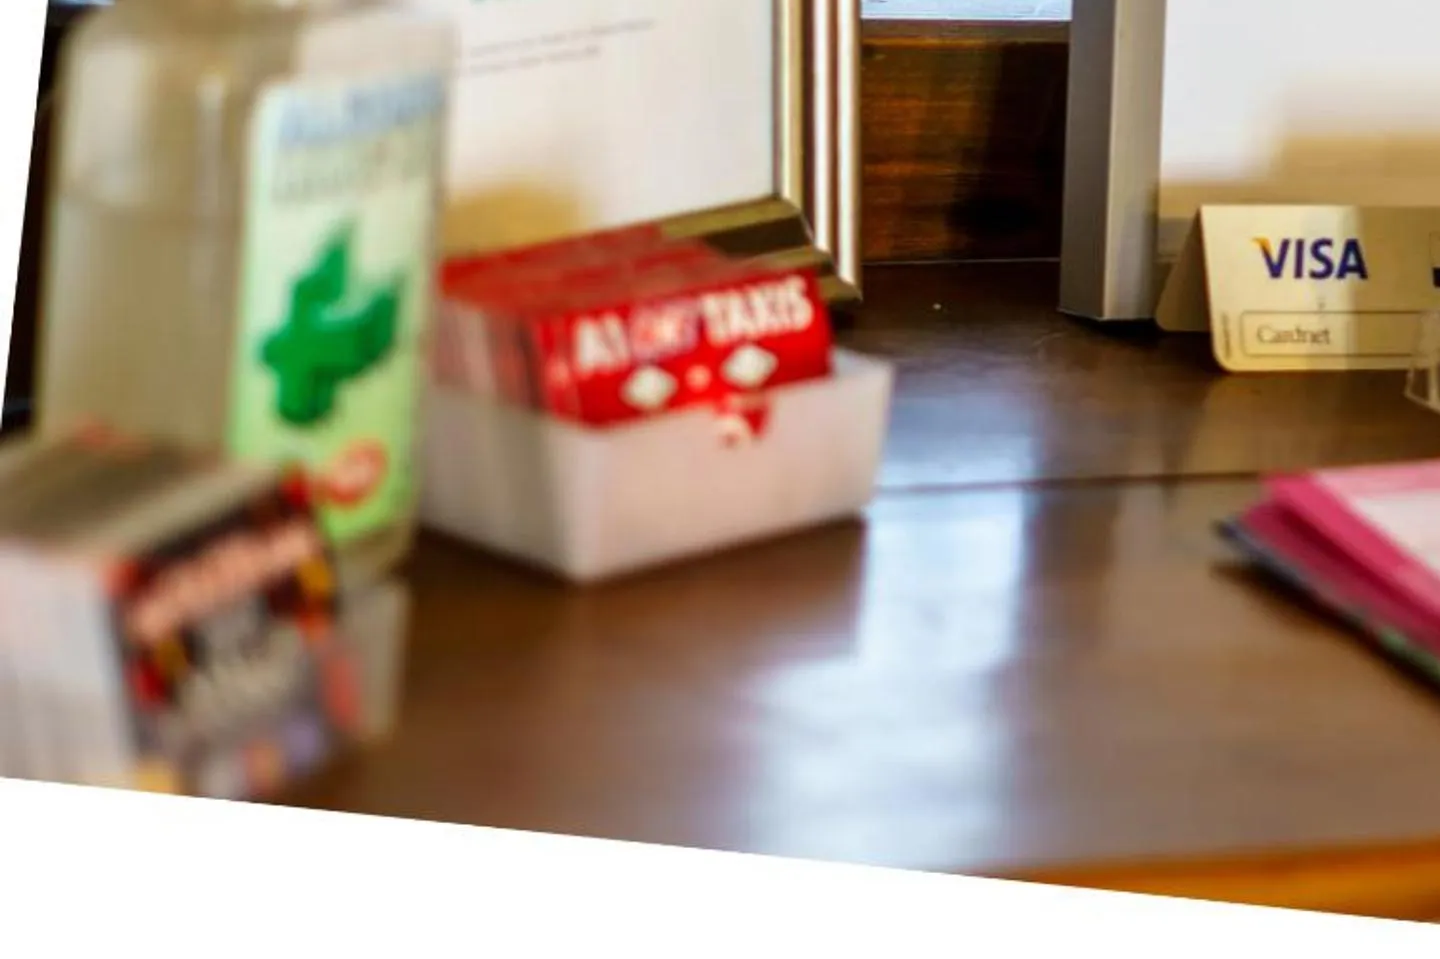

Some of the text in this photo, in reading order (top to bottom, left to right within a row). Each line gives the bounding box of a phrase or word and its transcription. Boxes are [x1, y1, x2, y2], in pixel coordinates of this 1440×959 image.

[1252, 236, 1369, 280] VISA
[702, 274, 815, 348] TAXIS
[1256, 324, 1330, 344] Cardnet
